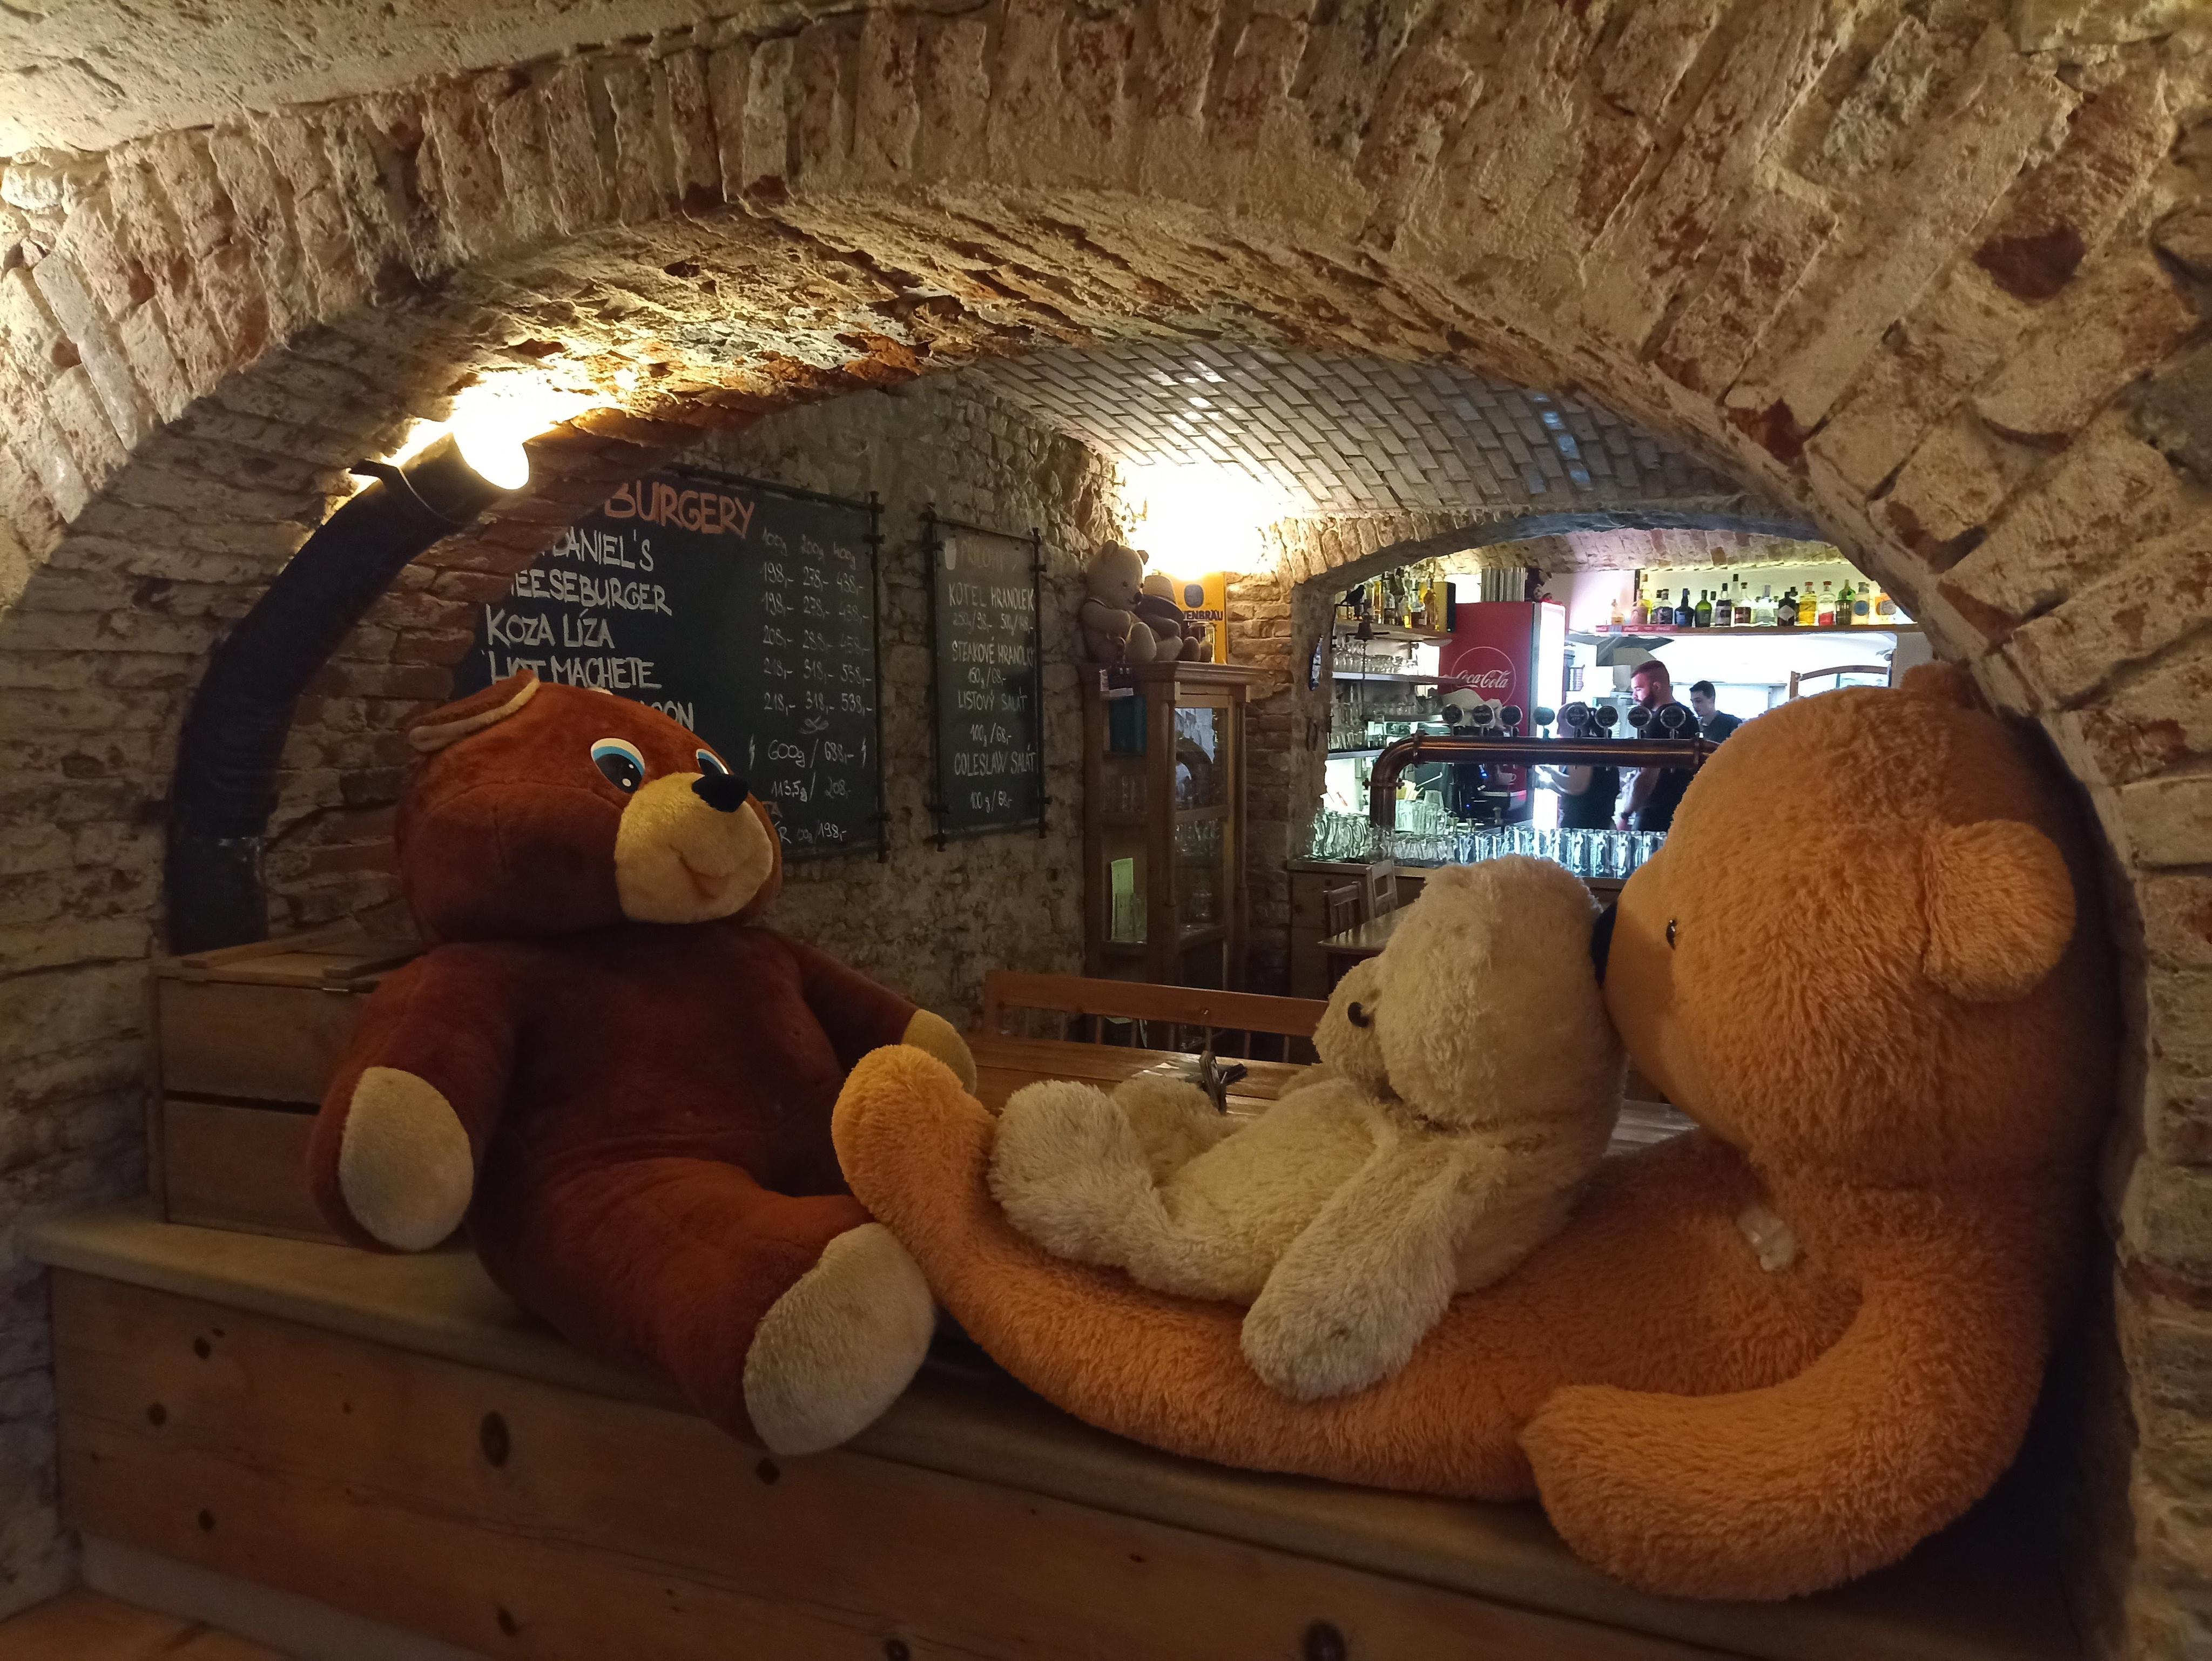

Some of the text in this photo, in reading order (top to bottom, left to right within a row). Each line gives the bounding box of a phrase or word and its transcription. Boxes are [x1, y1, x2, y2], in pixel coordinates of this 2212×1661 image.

[948, 582, 1035, 612] KOTEL HRANOLEK
[485, 603, 616, 649] KOZA LÍZA
[952, 636, 995, 665] STEAKOVÉ
[550, 655, 663, 690] MACHETE
[957, 688, 995, 712] LISTOVÝ
[954, 751, 1008, 777] COLESLAW
